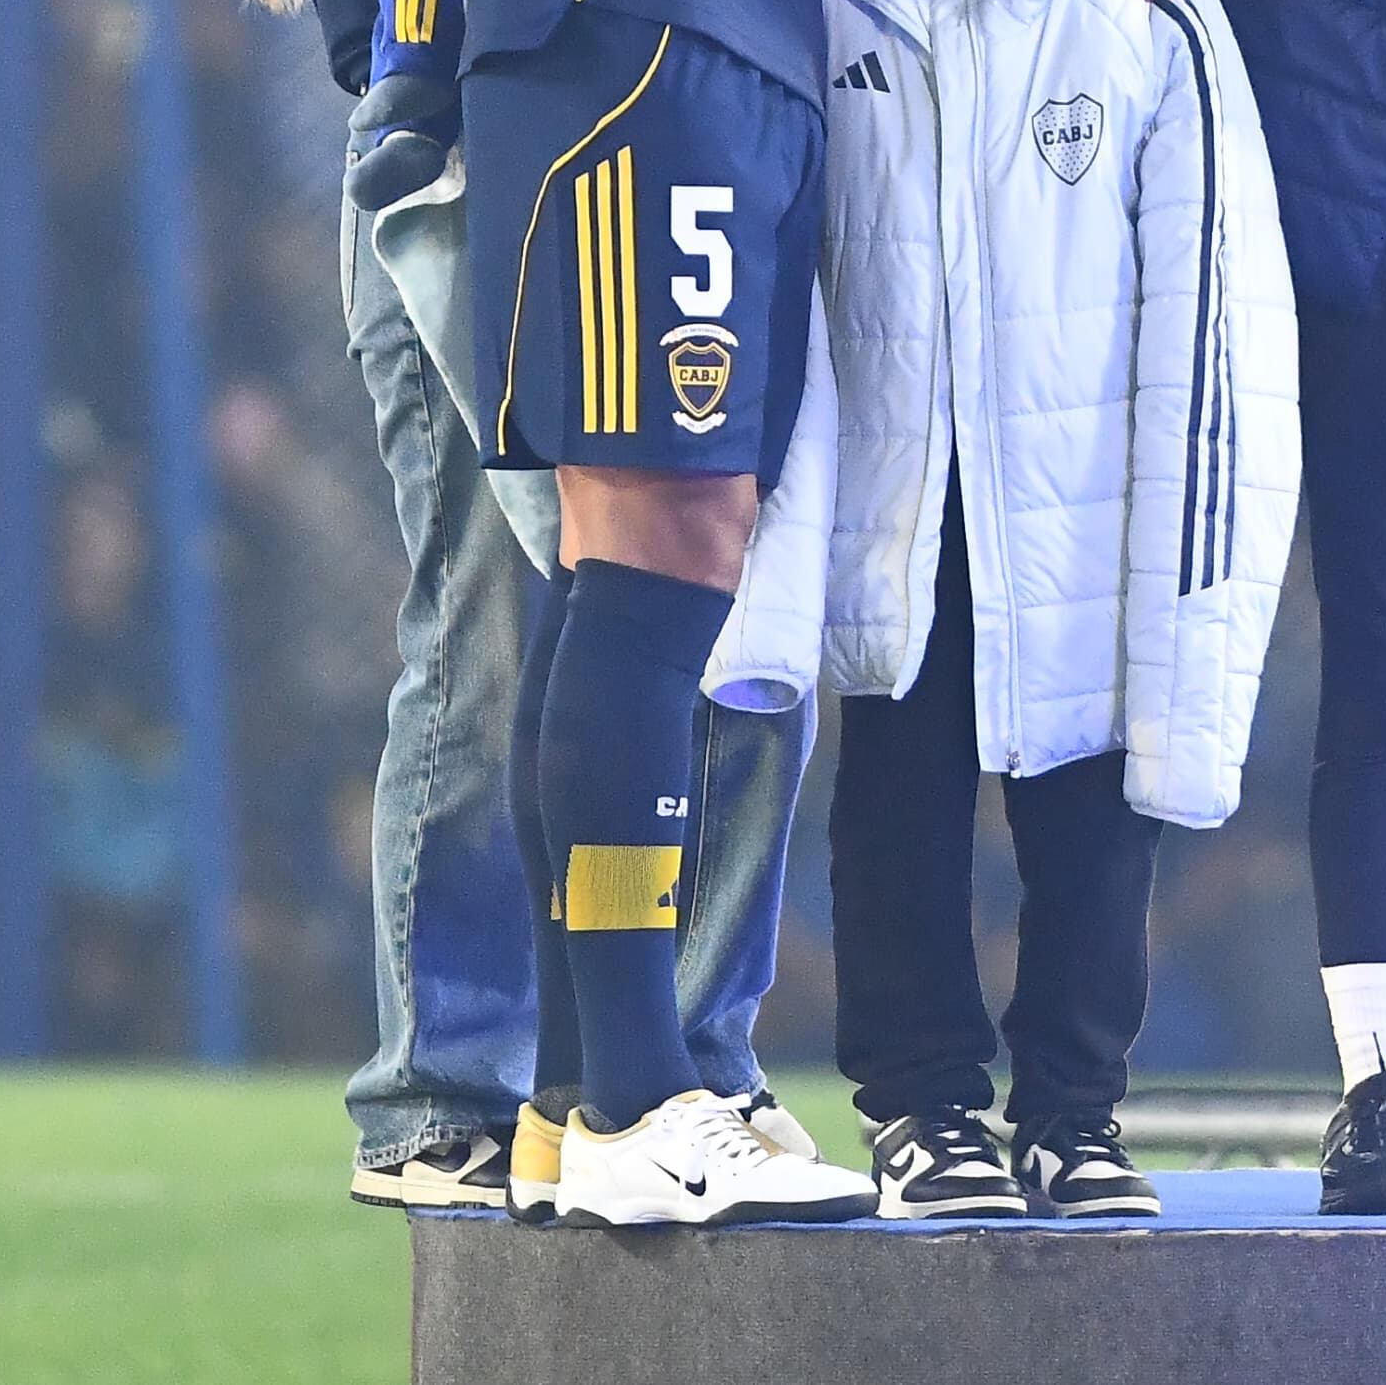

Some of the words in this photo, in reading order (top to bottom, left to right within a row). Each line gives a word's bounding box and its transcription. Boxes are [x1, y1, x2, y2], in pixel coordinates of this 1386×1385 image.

[1042, 123, 1093, 146] CABJ
[670, 185, 734, 318] 5
[679, 368, 719, 383] CABJ
